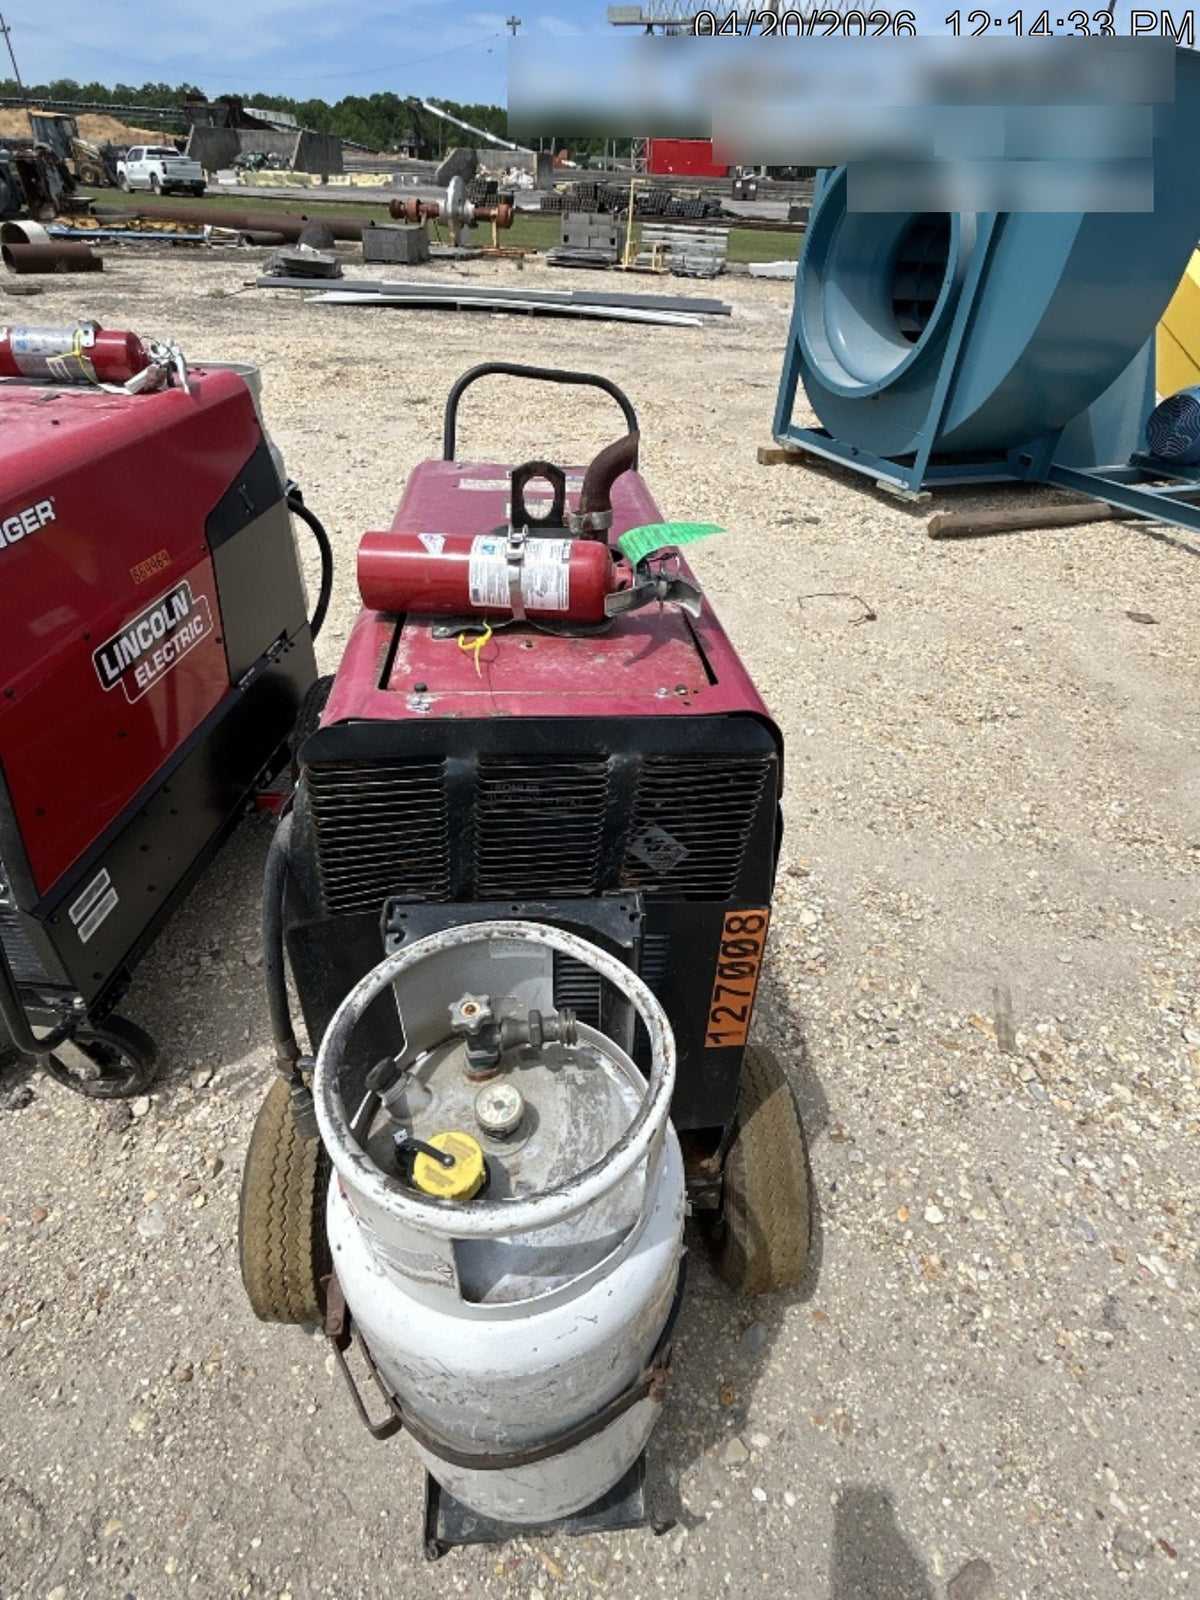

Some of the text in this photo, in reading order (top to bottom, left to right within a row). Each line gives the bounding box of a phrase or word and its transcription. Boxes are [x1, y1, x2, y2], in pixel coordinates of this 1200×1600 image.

[100, 590, 189, 681] LINCOLN
[134, 615, 204, 688] ELECTRIC
[707, 914, 766, 1045] 127008
